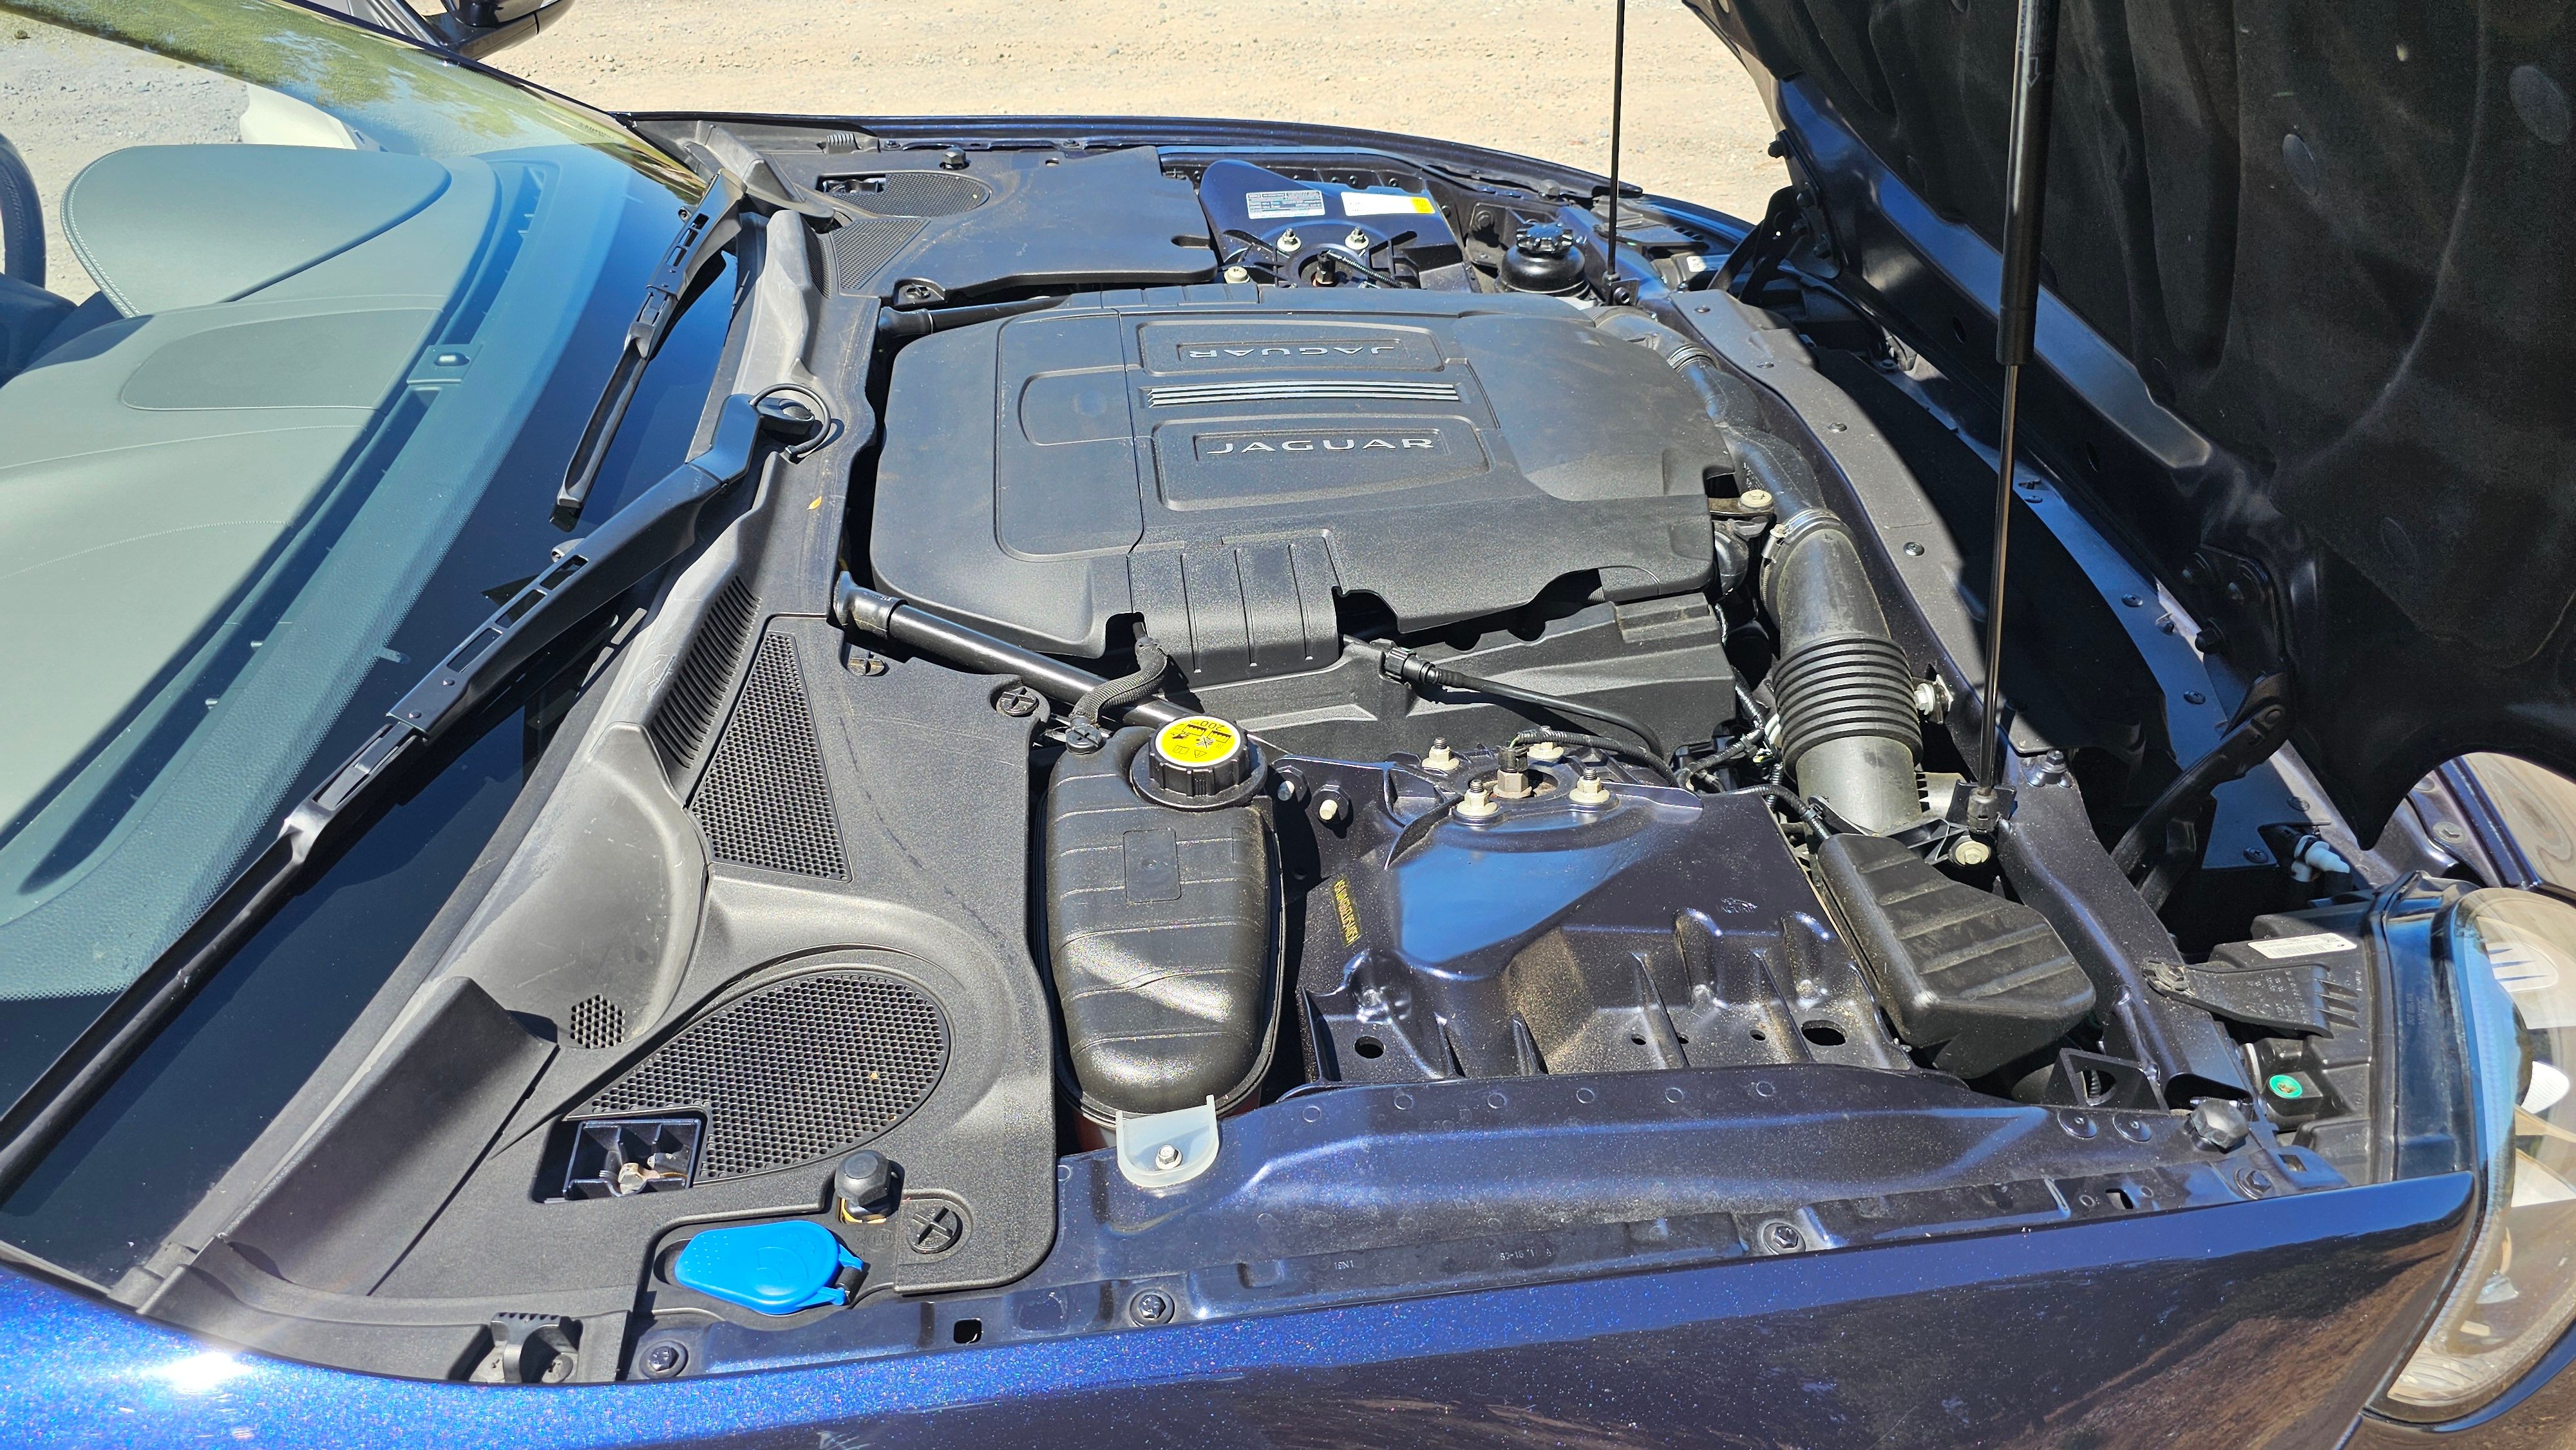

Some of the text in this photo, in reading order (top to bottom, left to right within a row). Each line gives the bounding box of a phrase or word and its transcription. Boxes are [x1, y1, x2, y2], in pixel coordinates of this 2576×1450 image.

[1188, 346, 1395, 358] JAGUAR
[1206, 438, 1435, 455] JAGUAR
[1200, 720, 1225, 732] 200
